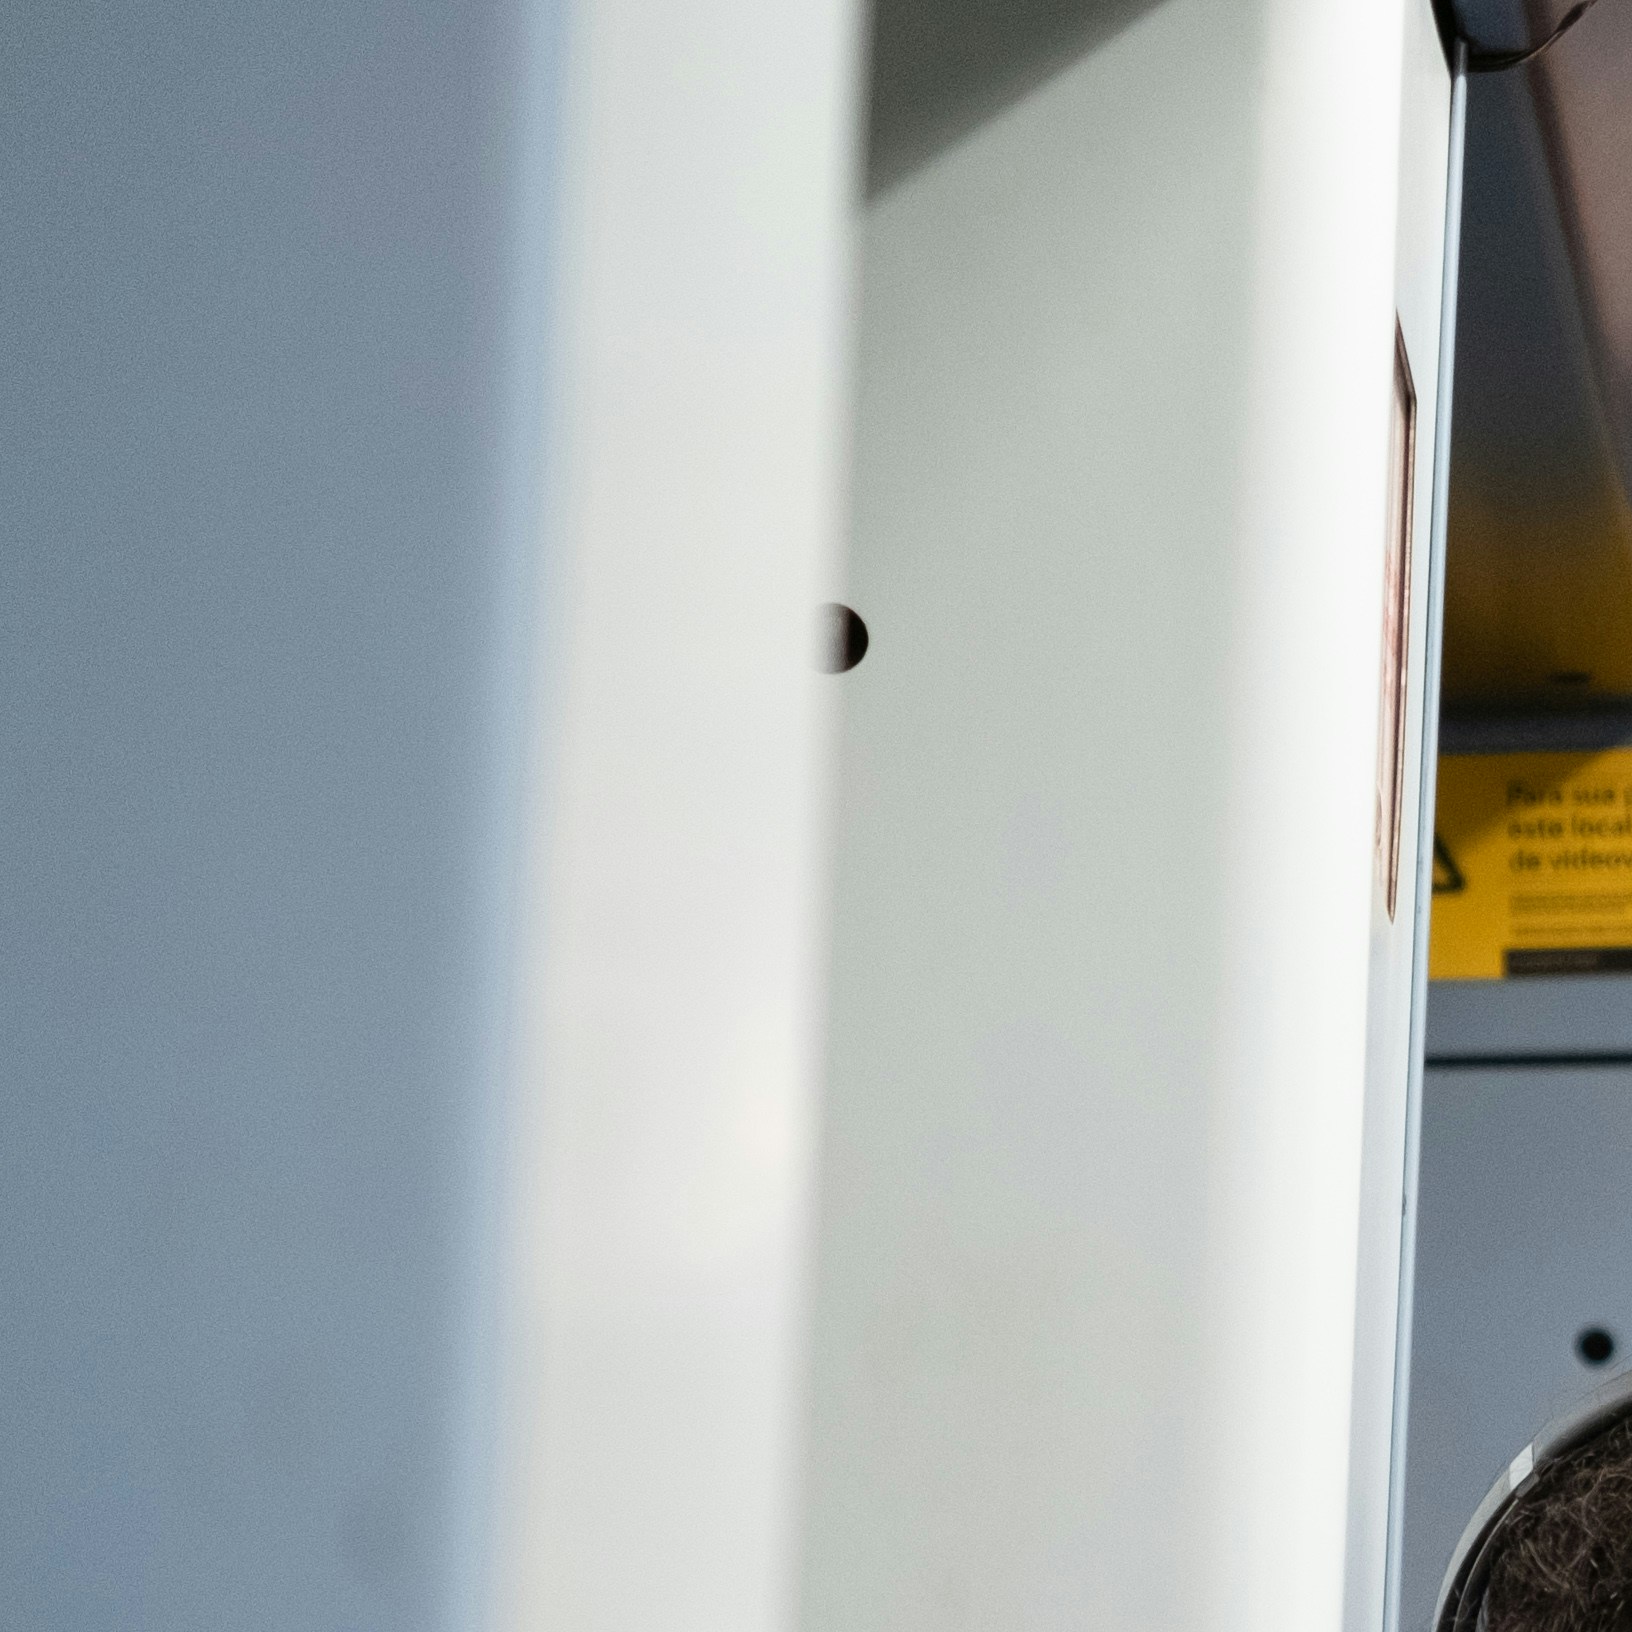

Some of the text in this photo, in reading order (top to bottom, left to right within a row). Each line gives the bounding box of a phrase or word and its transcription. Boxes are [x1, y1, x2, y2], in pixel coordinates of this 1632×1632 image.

[1505, 781, 1564, 806] Para
[1572, 786, 1616, 805] sua
[1506, 818, 1564, 839] este
[1570, 815, 1632, 838] local
[1509, 850, 1541, 873] de
